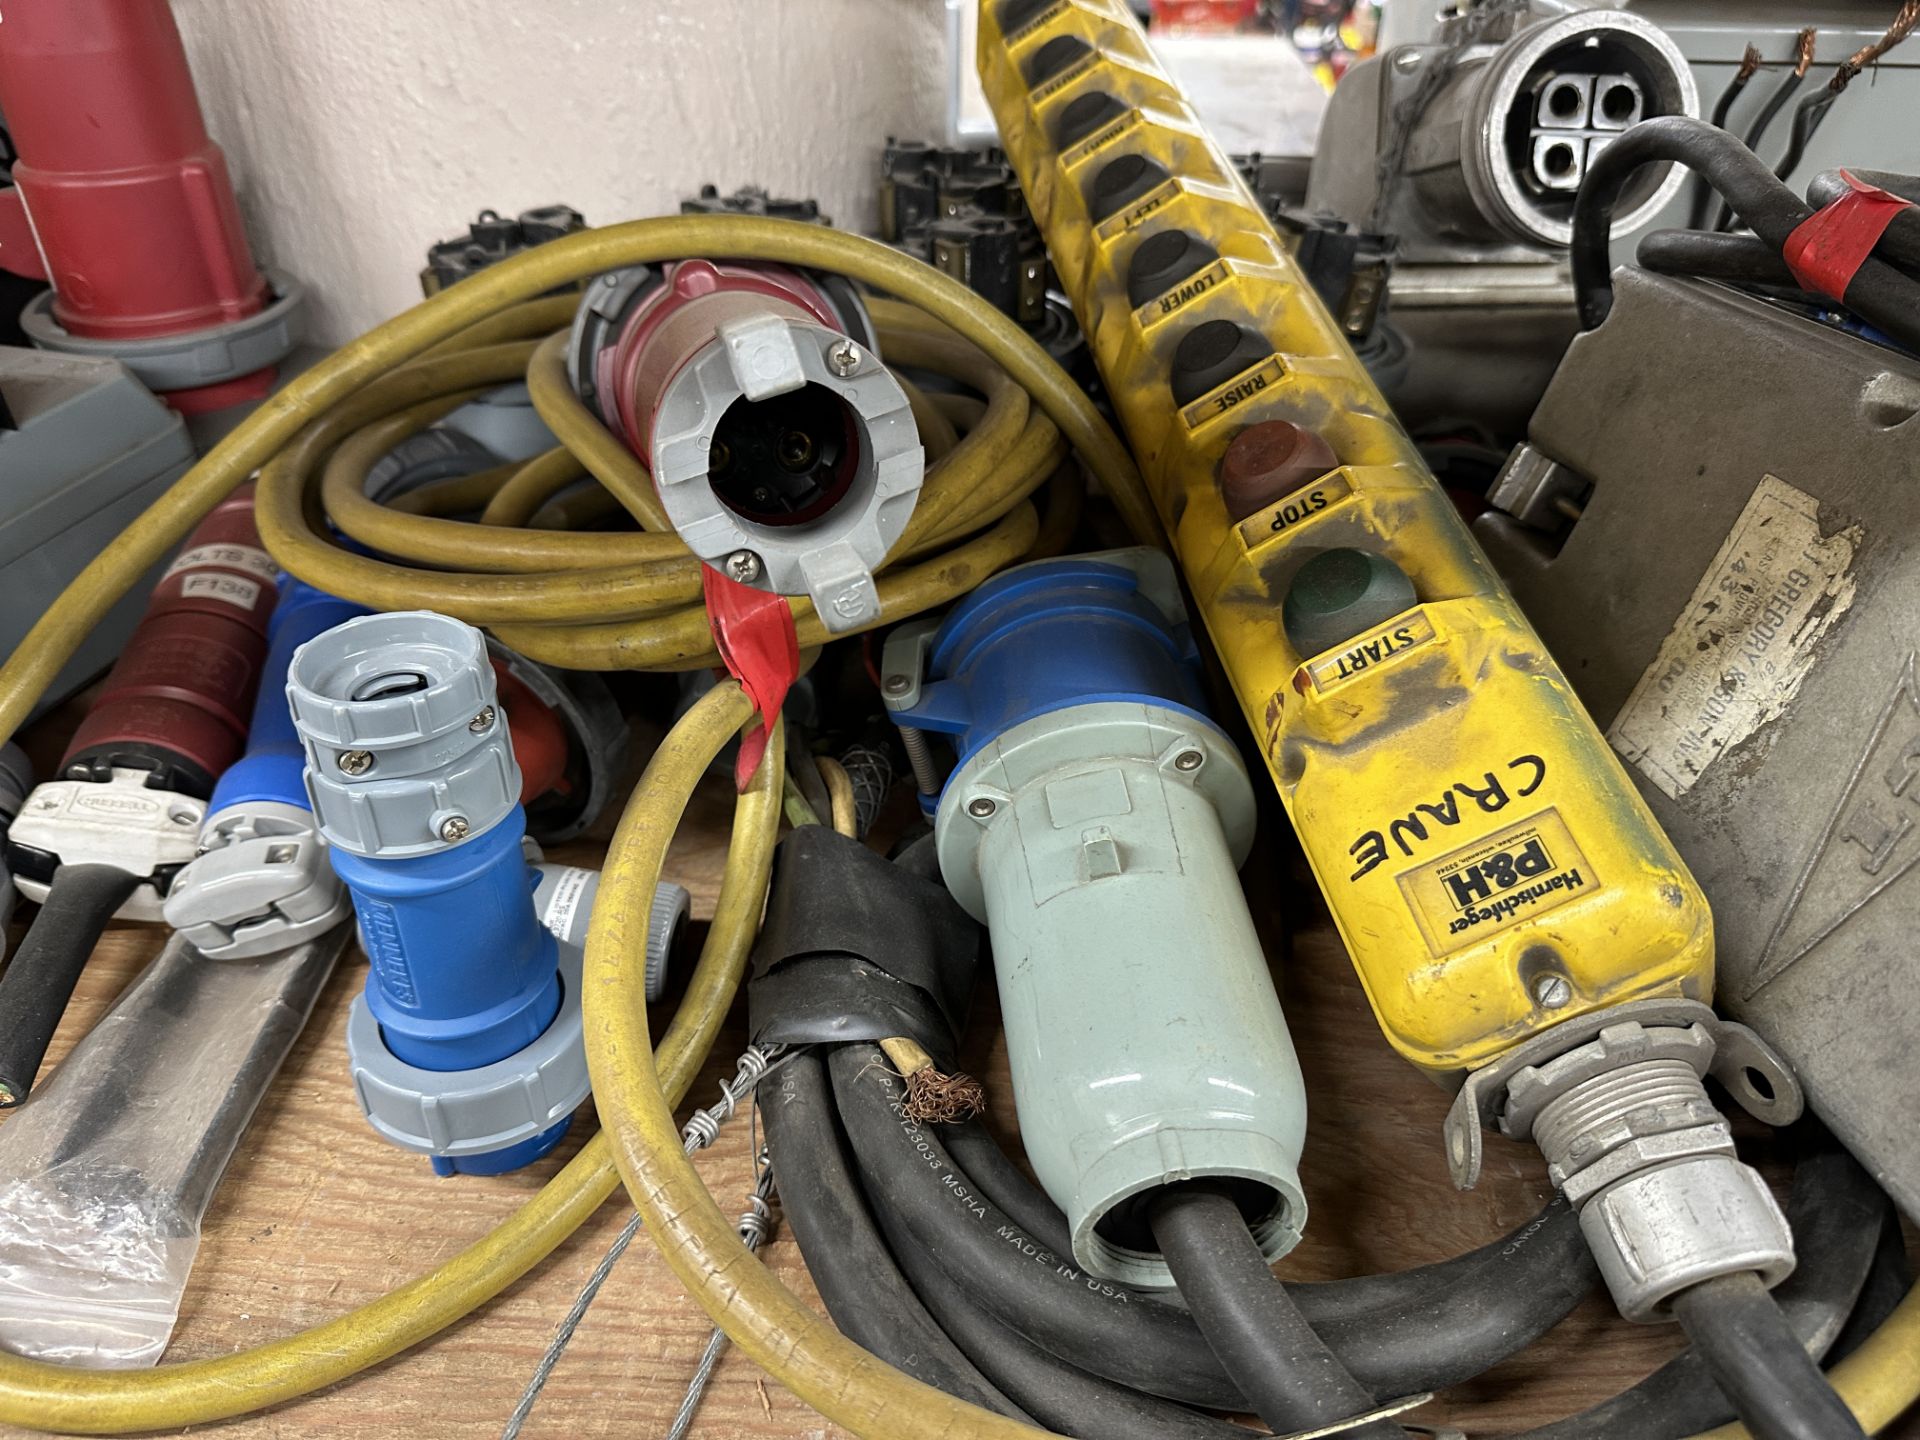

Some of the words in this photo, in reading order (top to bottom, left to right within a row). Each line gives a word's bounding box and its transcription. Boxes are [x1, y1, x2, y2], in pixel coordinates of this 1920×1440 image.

[1123, 198, 1160, 225] LEFT
[1159, 268, 1224, 313] LOWER
[1215, 372, 1267, 413] RAISE
[1270, 489, 1328, 531] STOP
[1740, 567, 1811, 667] GREGORY
[1332, 626, 1416, 681] START
[1727, 665, 1747, 683] &
[1349, 754, 1545, 882] CRANE
[1495, 826, 1536, 848] milwaukee,
[1447, 839, 1550, 906] P&H
[1458, 845, 1494, 864] wisconsin,
[1448, 868, 1583, 934] Harnischfeger
[780, 1068, 795, 1104] USA
[941, 1172, 986, 1218] MSHA
[995, 1225, 1048, 1264] MADE
[1055, 1264, 1079, 1281] IN
[1087, 1278, 1127, 1303] USA
